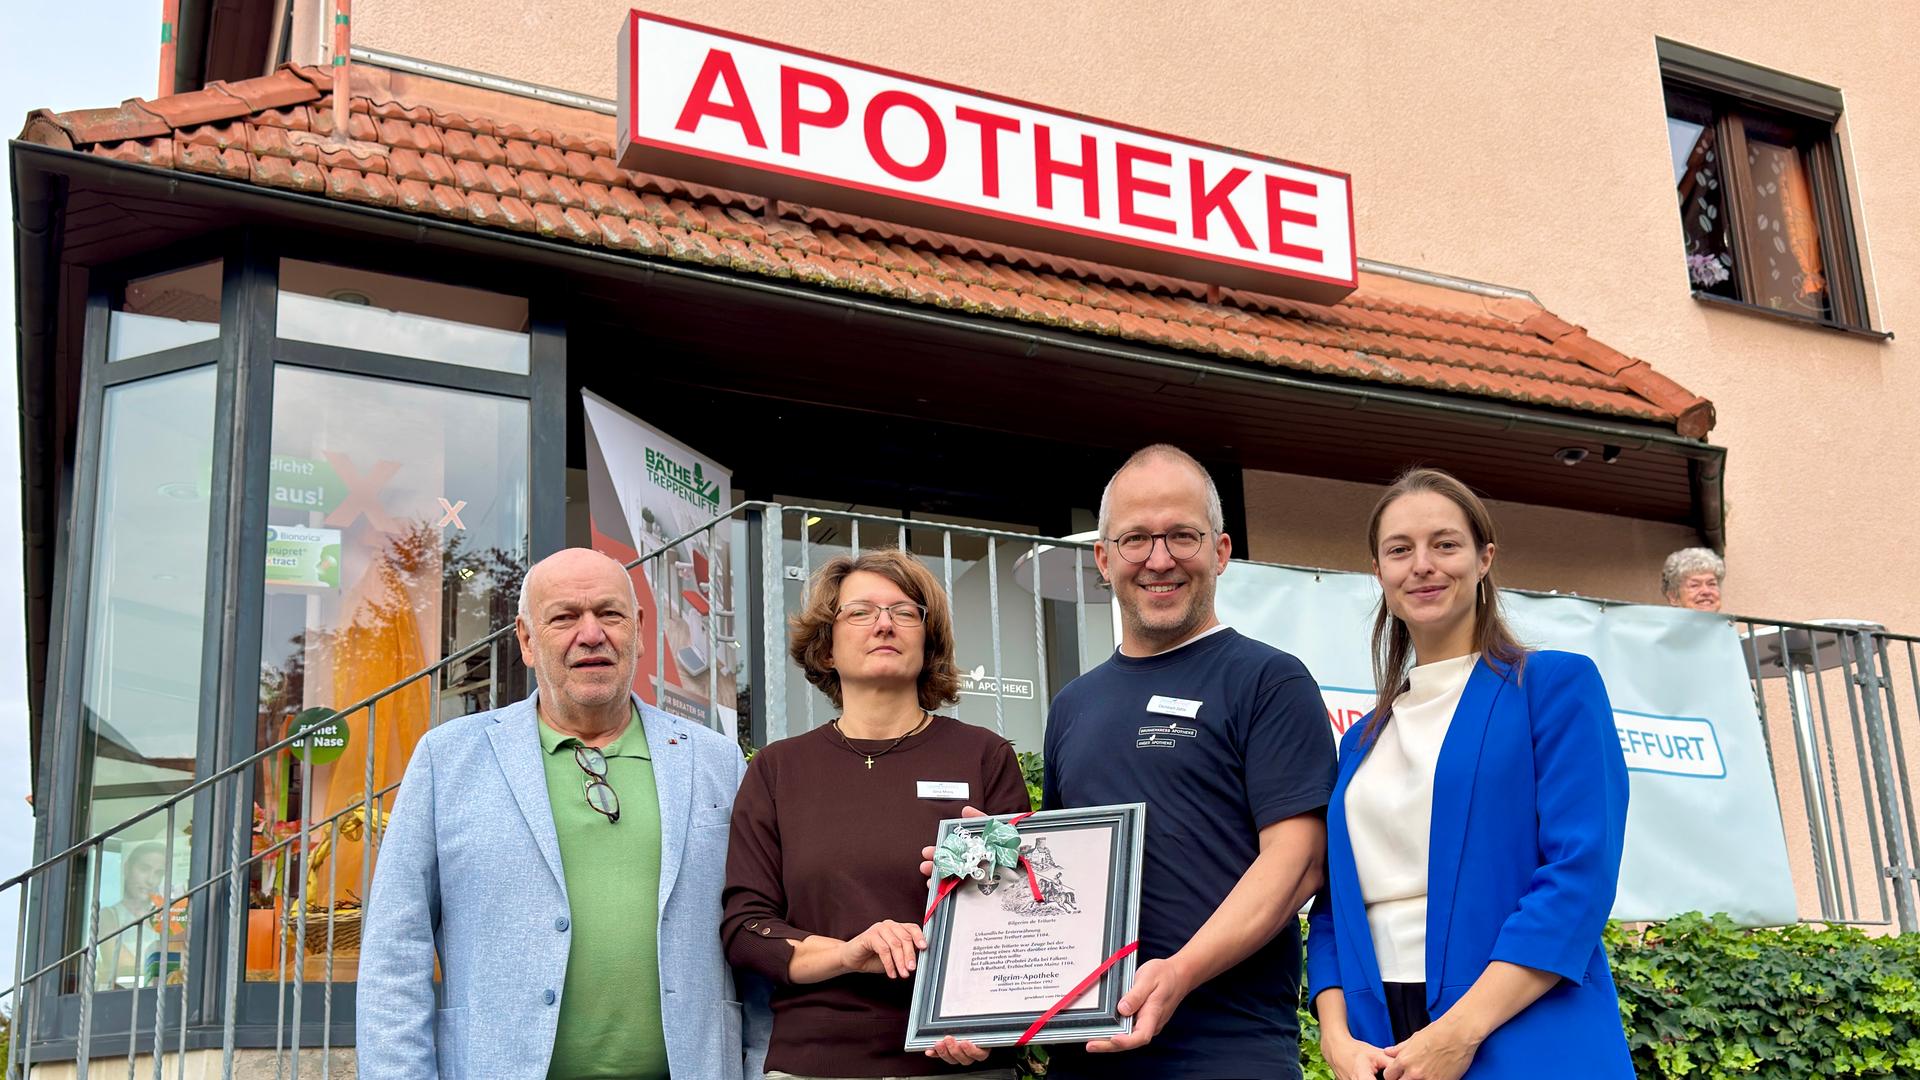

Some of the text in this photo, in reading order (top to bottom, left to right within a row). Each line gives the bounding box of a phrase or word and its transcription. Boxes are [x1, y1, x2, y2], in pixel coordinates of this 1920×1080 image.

[675, 47, 1324, 263] APOTHEKE
[270, 459, 314, 476] dicht?
[645, 447, 691, 485] BÄTHE
[274, 486, 324, 506] aus!
[646, 467, 719, 517] TREPPENLIFTE
[280, 532, 320, 542] Bionorica
[978, 681, 1028, 694] APOHEKE
[313, 736, 344, 748] Nase
[992, 972, 1060, 982] Pilgrim-Apotheke
